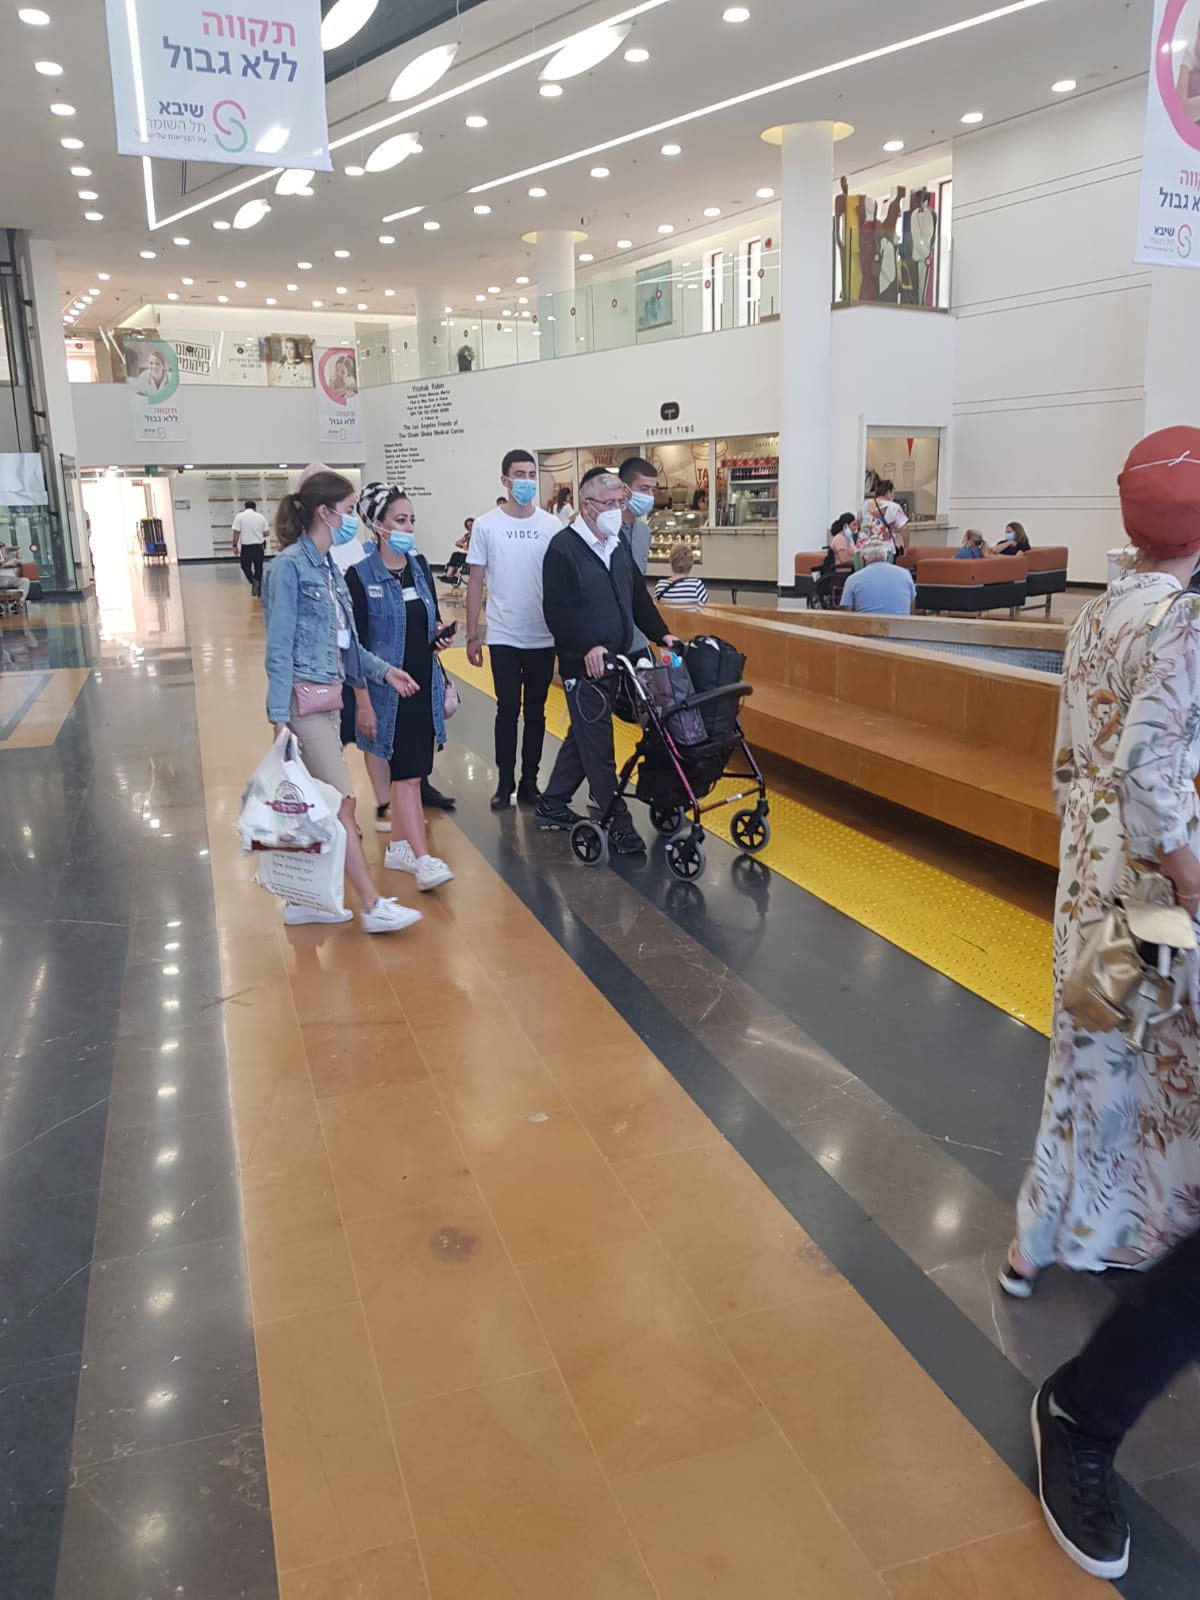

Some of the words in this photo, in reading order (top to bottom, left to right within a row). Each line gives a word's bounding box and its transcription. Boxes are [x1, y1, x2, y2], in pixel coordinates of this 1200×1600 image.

[202, 10, 296, 47] תקווה
[162, 36, 232, 75] גבול
[241, 49, 298, 82] ללא
[158, 100, 204, 118] שיבא
[189, 119, 206, 133] תל
[1159, 186, 1189, 210] גבול
[1153, 226, 1175, 237] שיבא
[646, 426, 673, 437] COFFEE
[676, 424, 695, 433] TIME
[696, 467, 723, 480] TAE
[506, 530, 540, 539] VIBES
